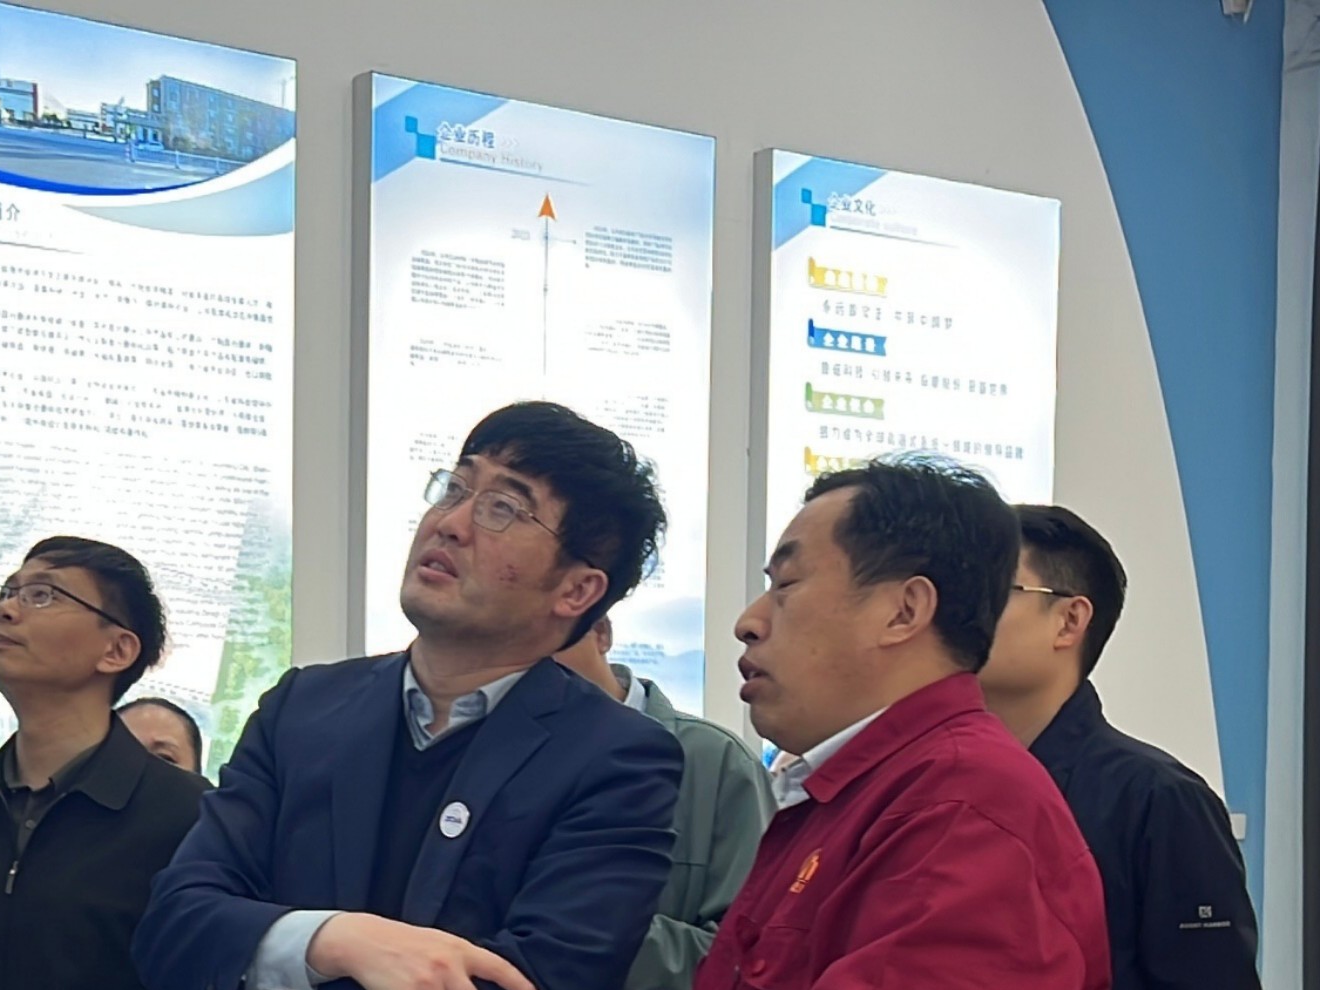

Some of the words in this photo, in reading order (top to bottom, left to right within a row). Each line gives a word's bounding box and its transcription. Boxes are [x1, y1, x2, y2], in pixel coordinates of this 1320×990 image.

[440, 123, 495, 148] 企业历程
[440, 142, 496, 164] Company
[501, 151, 543, 172] History
[828, 191, 877, 217] 企业文化
